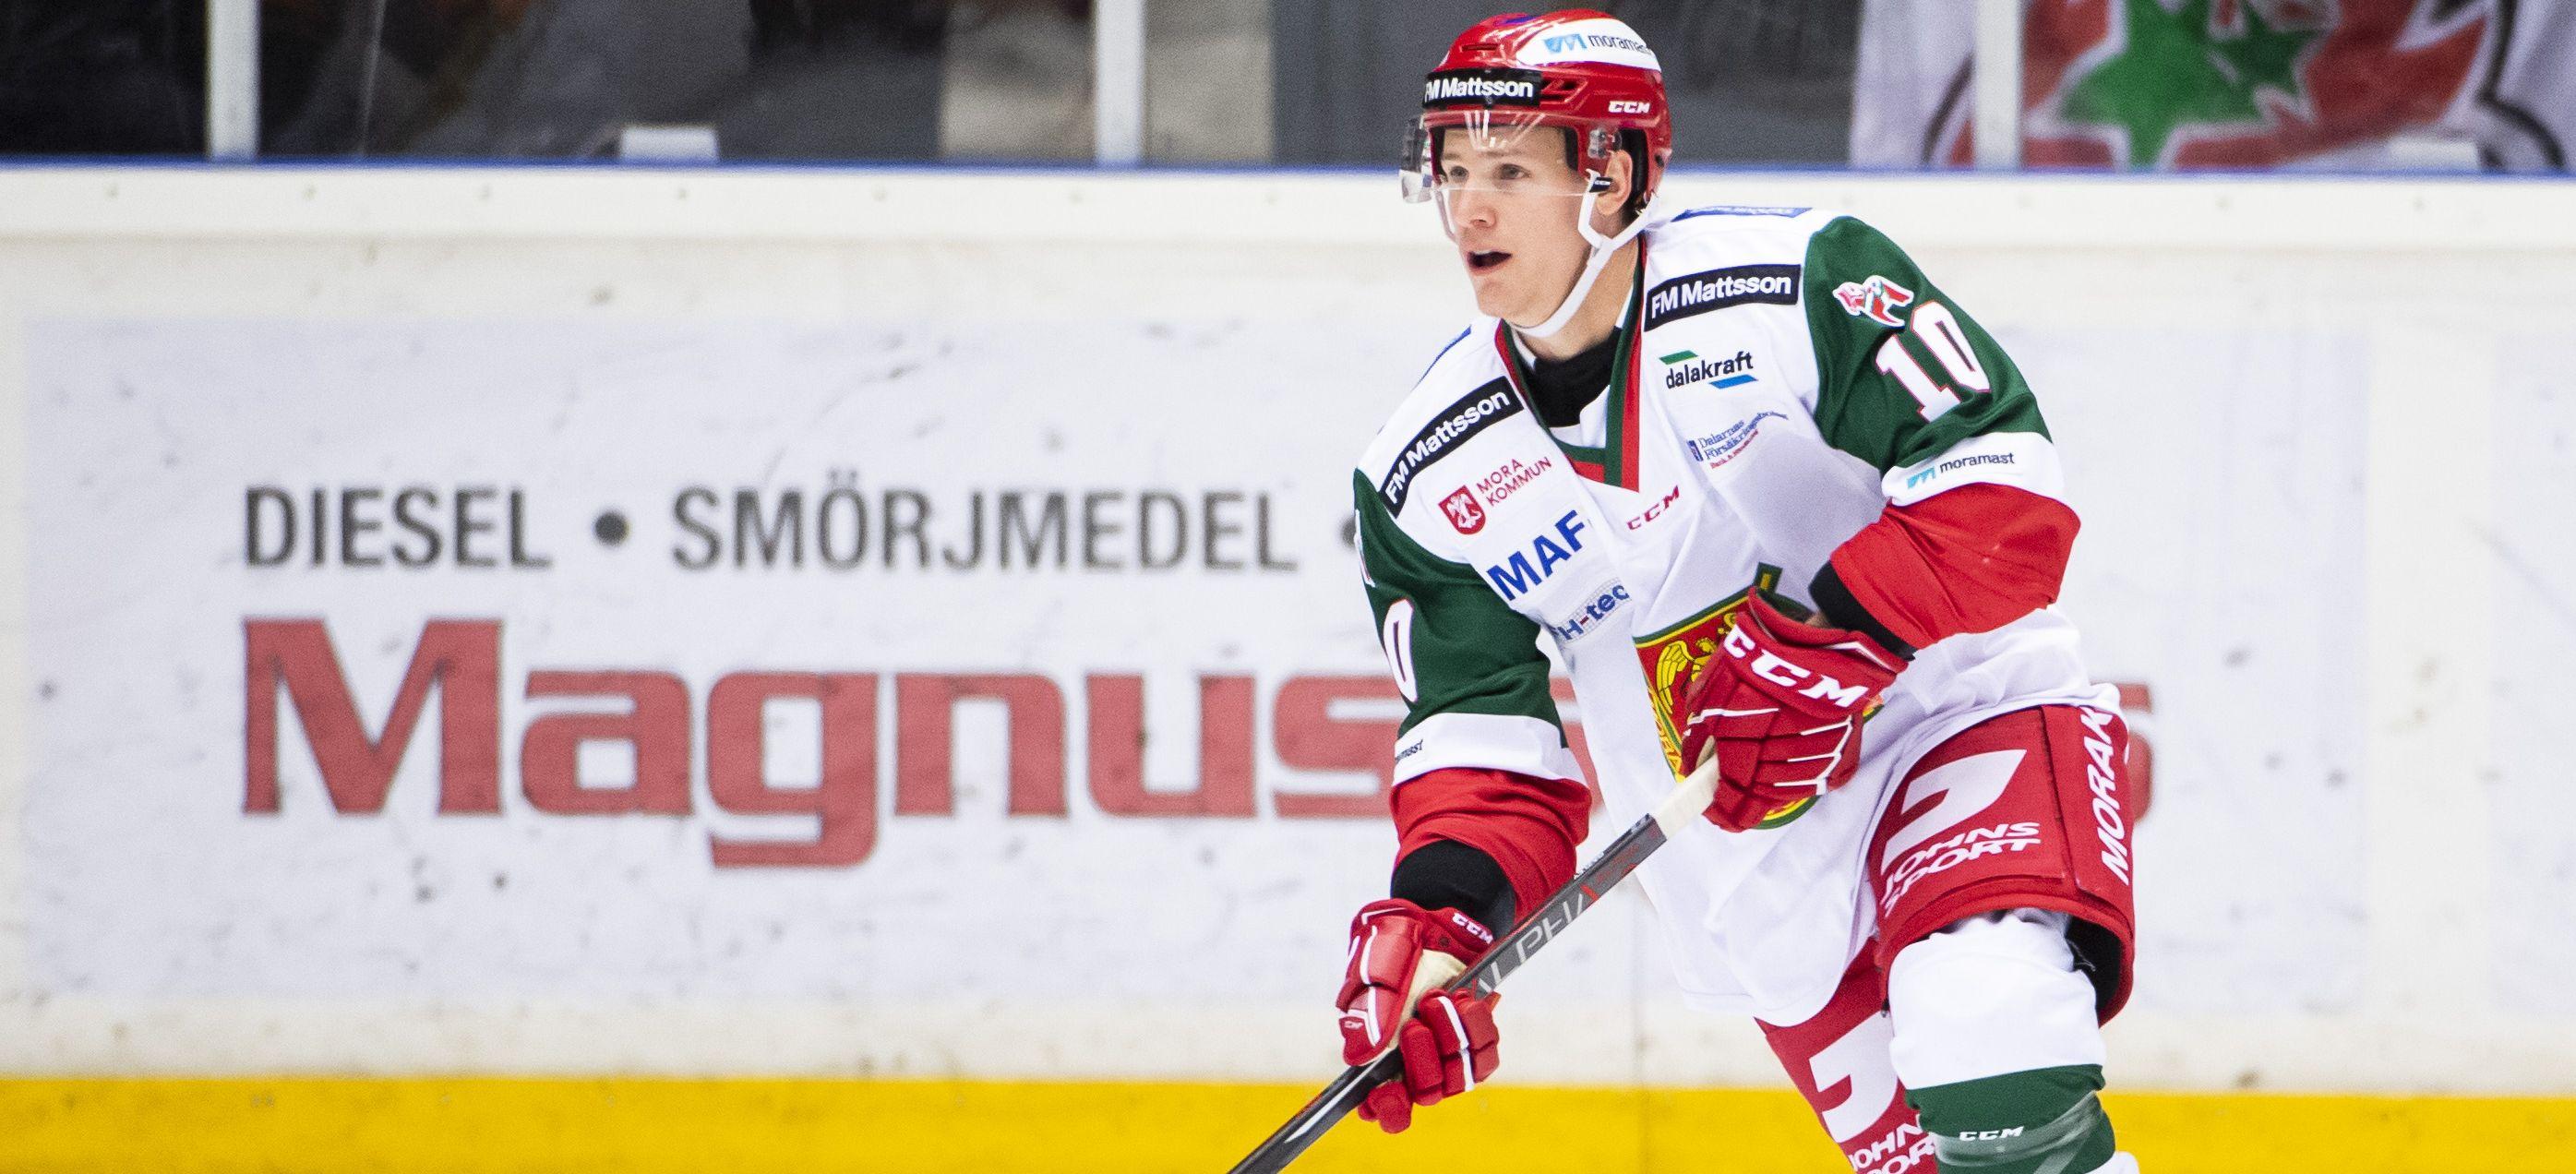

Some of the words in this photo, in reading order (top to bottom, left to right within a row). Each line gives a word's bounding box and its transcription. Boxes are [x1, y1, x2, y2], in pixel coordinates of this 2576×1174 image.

[1441, 77, 1534, 99] Mattsson
[1608, 100, 1651, 114] CCM
[1651, 286, 1679, 319] FM
[1681, 276, 1791, 306] Mattsson
[1666, 351, 1755, 389] dalakraft
[1875, 299, 1993, 425] 10
[1384, 460, 1410, 505] FM
[1406, 391, 1511, 467] Mattsson
[1939, 451, 2016, 473] moramast
[1477, 458, 1524, 495] MORA
[1485, 456, 1552, 507] KOMMUN
[245, 485, 550, 569] DIESEL
[673, 468, 1298, 571] SMÖRJMEDEL
[1626, 485, 1680, 531] CCM
[1486, 509, 1586, 602] MAF
[1724, 623, 1870, 708] CCM
[1880, 821, 2041, 905] JOHNS
[1884, 838, 2042, 919] SPORT
[1452, 912, 1494, 945] CCM
[1959, 1126, 2025, 1143] CCM
